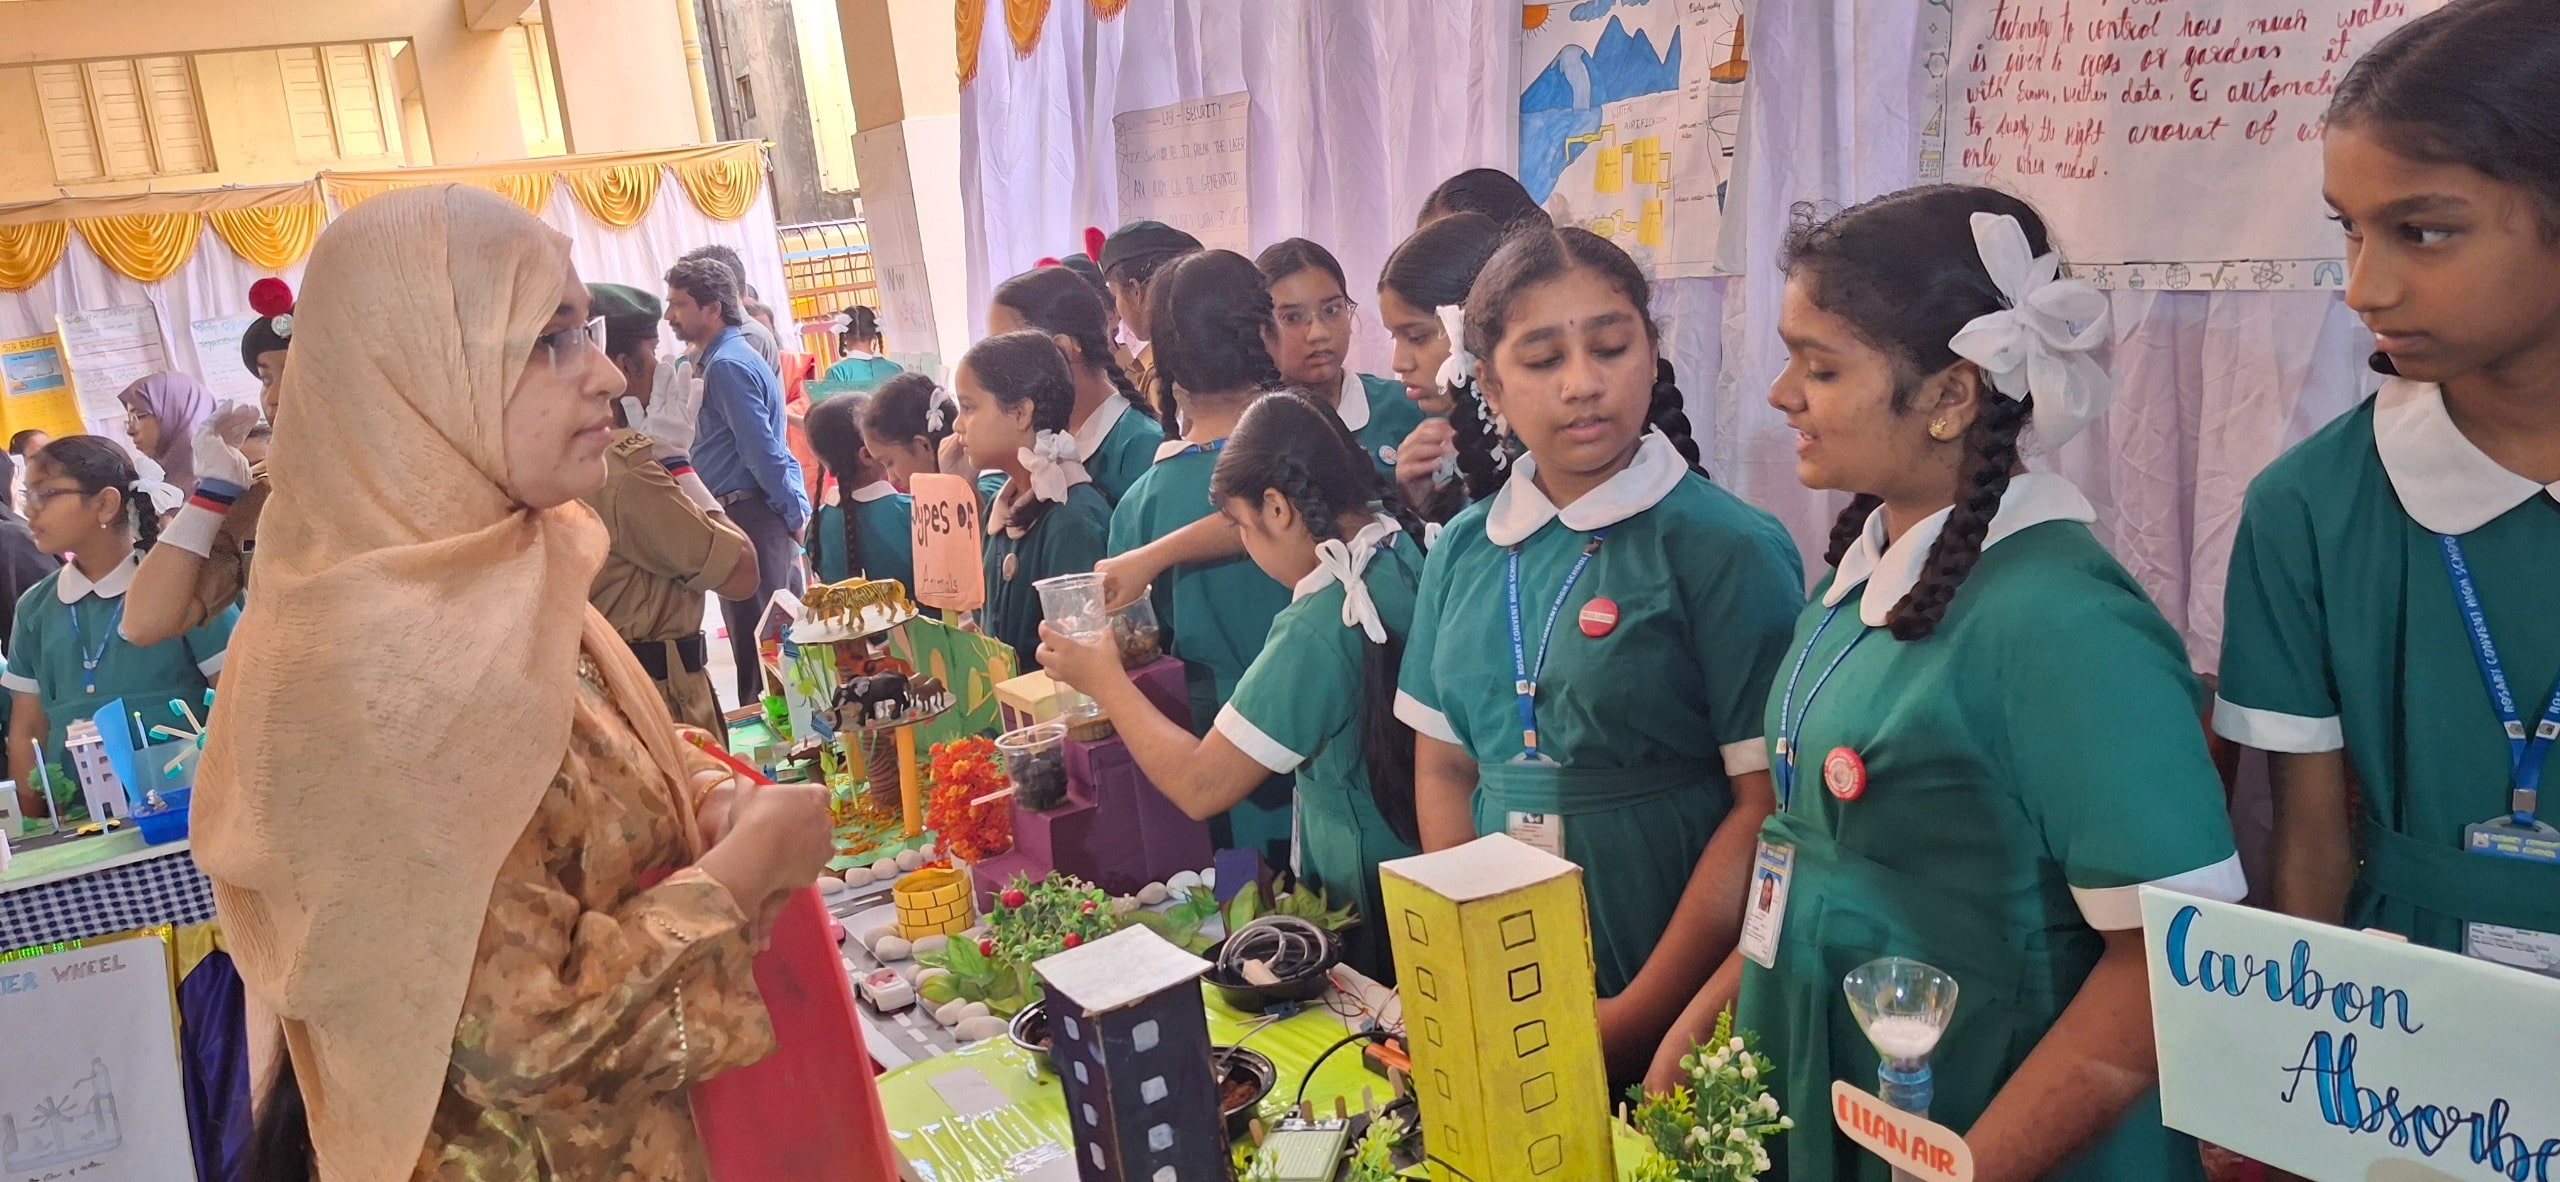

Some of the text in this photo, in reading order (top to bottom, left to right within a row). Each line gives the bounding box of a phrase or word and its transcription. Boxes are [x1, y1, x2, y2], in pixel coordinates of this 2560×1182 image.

[2059, 0, 2074, 44] to
[2089, 7, 2161, 41] control
[2175, 11, 2222, 38] how
[2247, 9, 2307, 36] much
[2337, 0, 2405, 30] water
[1969, 44, 1987, 73] is
[2003, 44, 2043, 85] given
[2051, 45, 2063, 72] to
[2140, 48, 2169, 72] or
[2179, 37, 2282, 82] gardens
[2322, 29, 2352, 64] it
[1966, 75, 2004, 104] with
[2227, 70, 2340, 104] automati
[1964, 106, 1985, 137] to
[2064, 117, 2106, 158] right
[2128, 115, 2230, 145] amount
[2245, 109, 2279, 146] of
[1962, 137, 2002, 184] only
[2016, 144, 2046, 175] when
[19, 336, 56, 351] BREEZE
[615, 433, 647, 452] NCC
[957, 501, 974, 540] of
[1509, 554, 1525, 676] ROSARY CONVENT HIGH SCHOOL
[1541, 606, 1558, 643] CONVENT
[1555, 585, 1569, 605] HIGH
[1566, 556, 1588, 585] SCHOOL
[2444, 535, 2515, 713] ROSARY CONVENT HIGH SCHOO
[51, 954, 127, 984] WHEEL
[2165, 904, 2424, 1034] Carbon
[1837, 1093, 1956, 1177] CLEAN AIR
